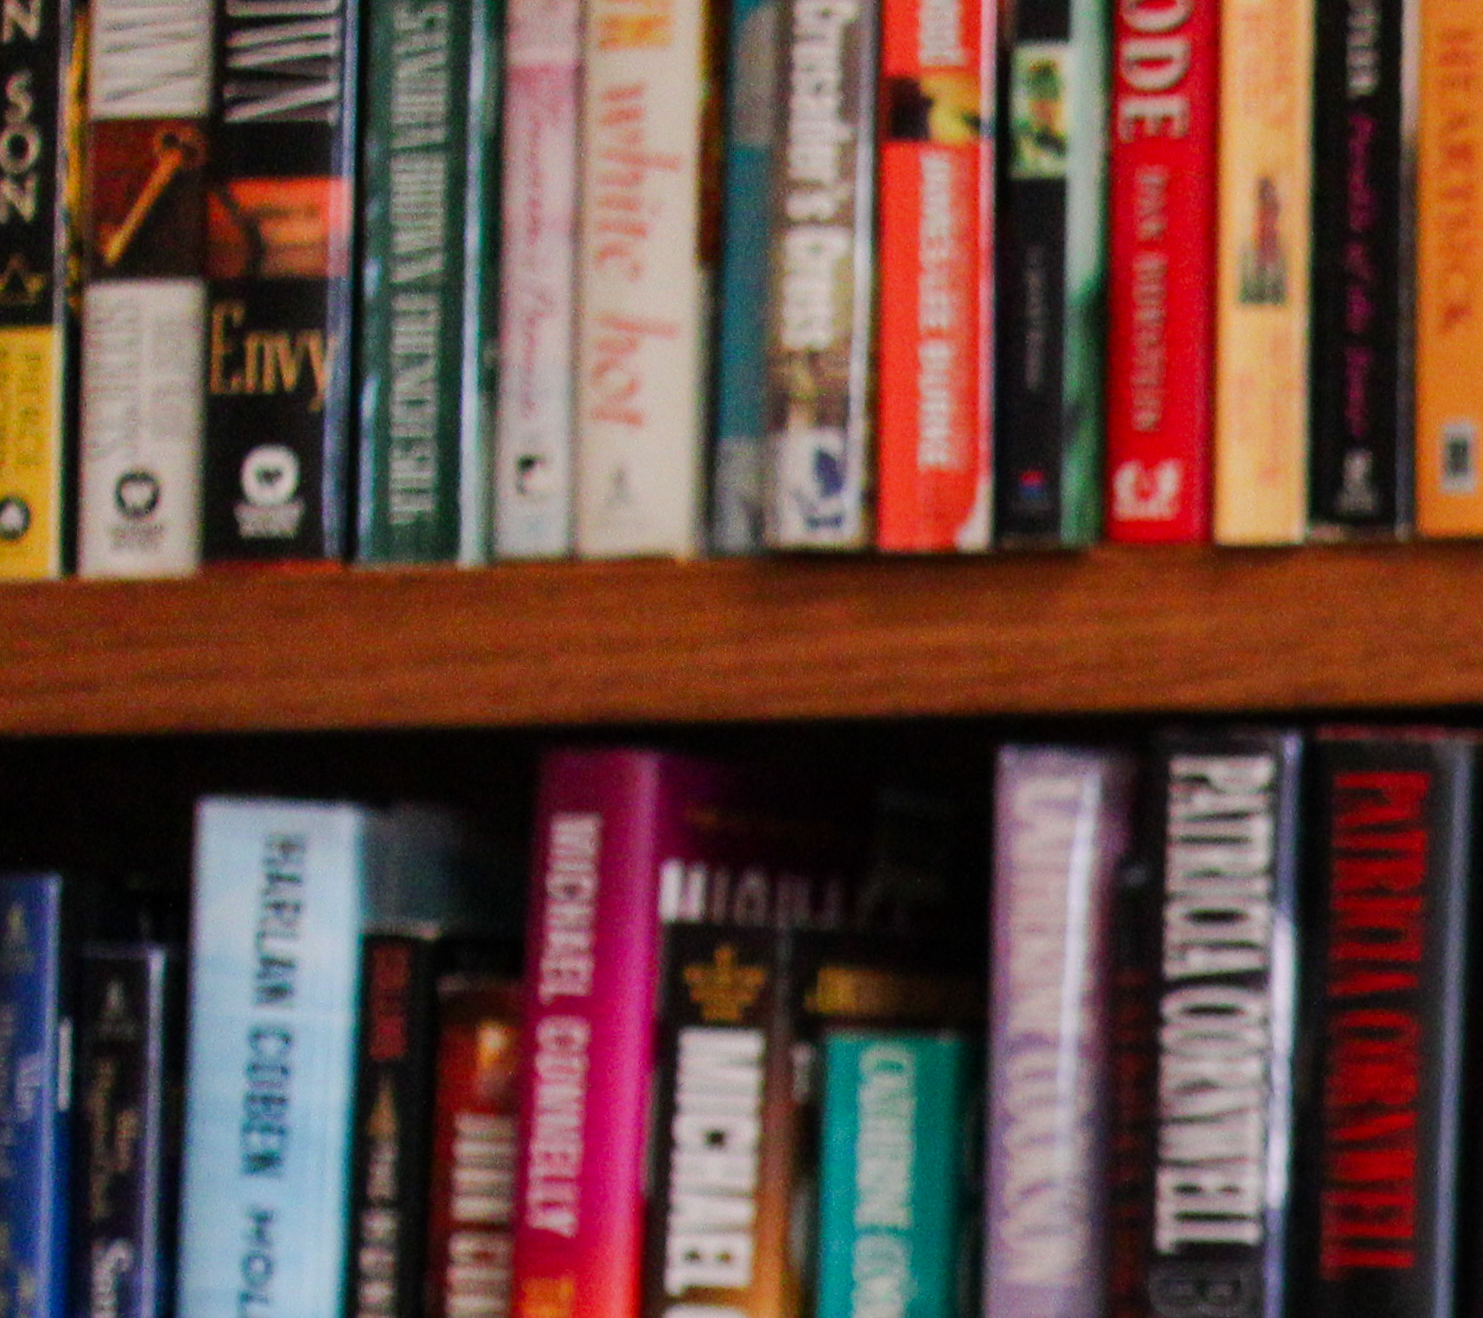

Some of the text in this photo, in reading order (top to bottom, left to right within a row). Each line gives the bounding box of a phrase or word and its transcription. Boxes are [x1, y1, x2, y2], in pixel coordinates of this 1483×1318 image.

[208, 298, 345, 412] Envy
[249, 833, 307, 1005] HARLAN
[532, 813, 599, 1004] MICHAEL
[1166, 754, 1275, 977] PATRICIA
[1330, 771, 1429, 996] PATRICIA
[236, 1024, 296, 1180] COBEN
[522, 1016, 592, 1237] CONNELLY
[664, 1027, 767, 1297] MICHAEL
[1153, 987, 1272, 1255] CORNWELL
[1318, 1006, 1425, 1283] CORNWELL
